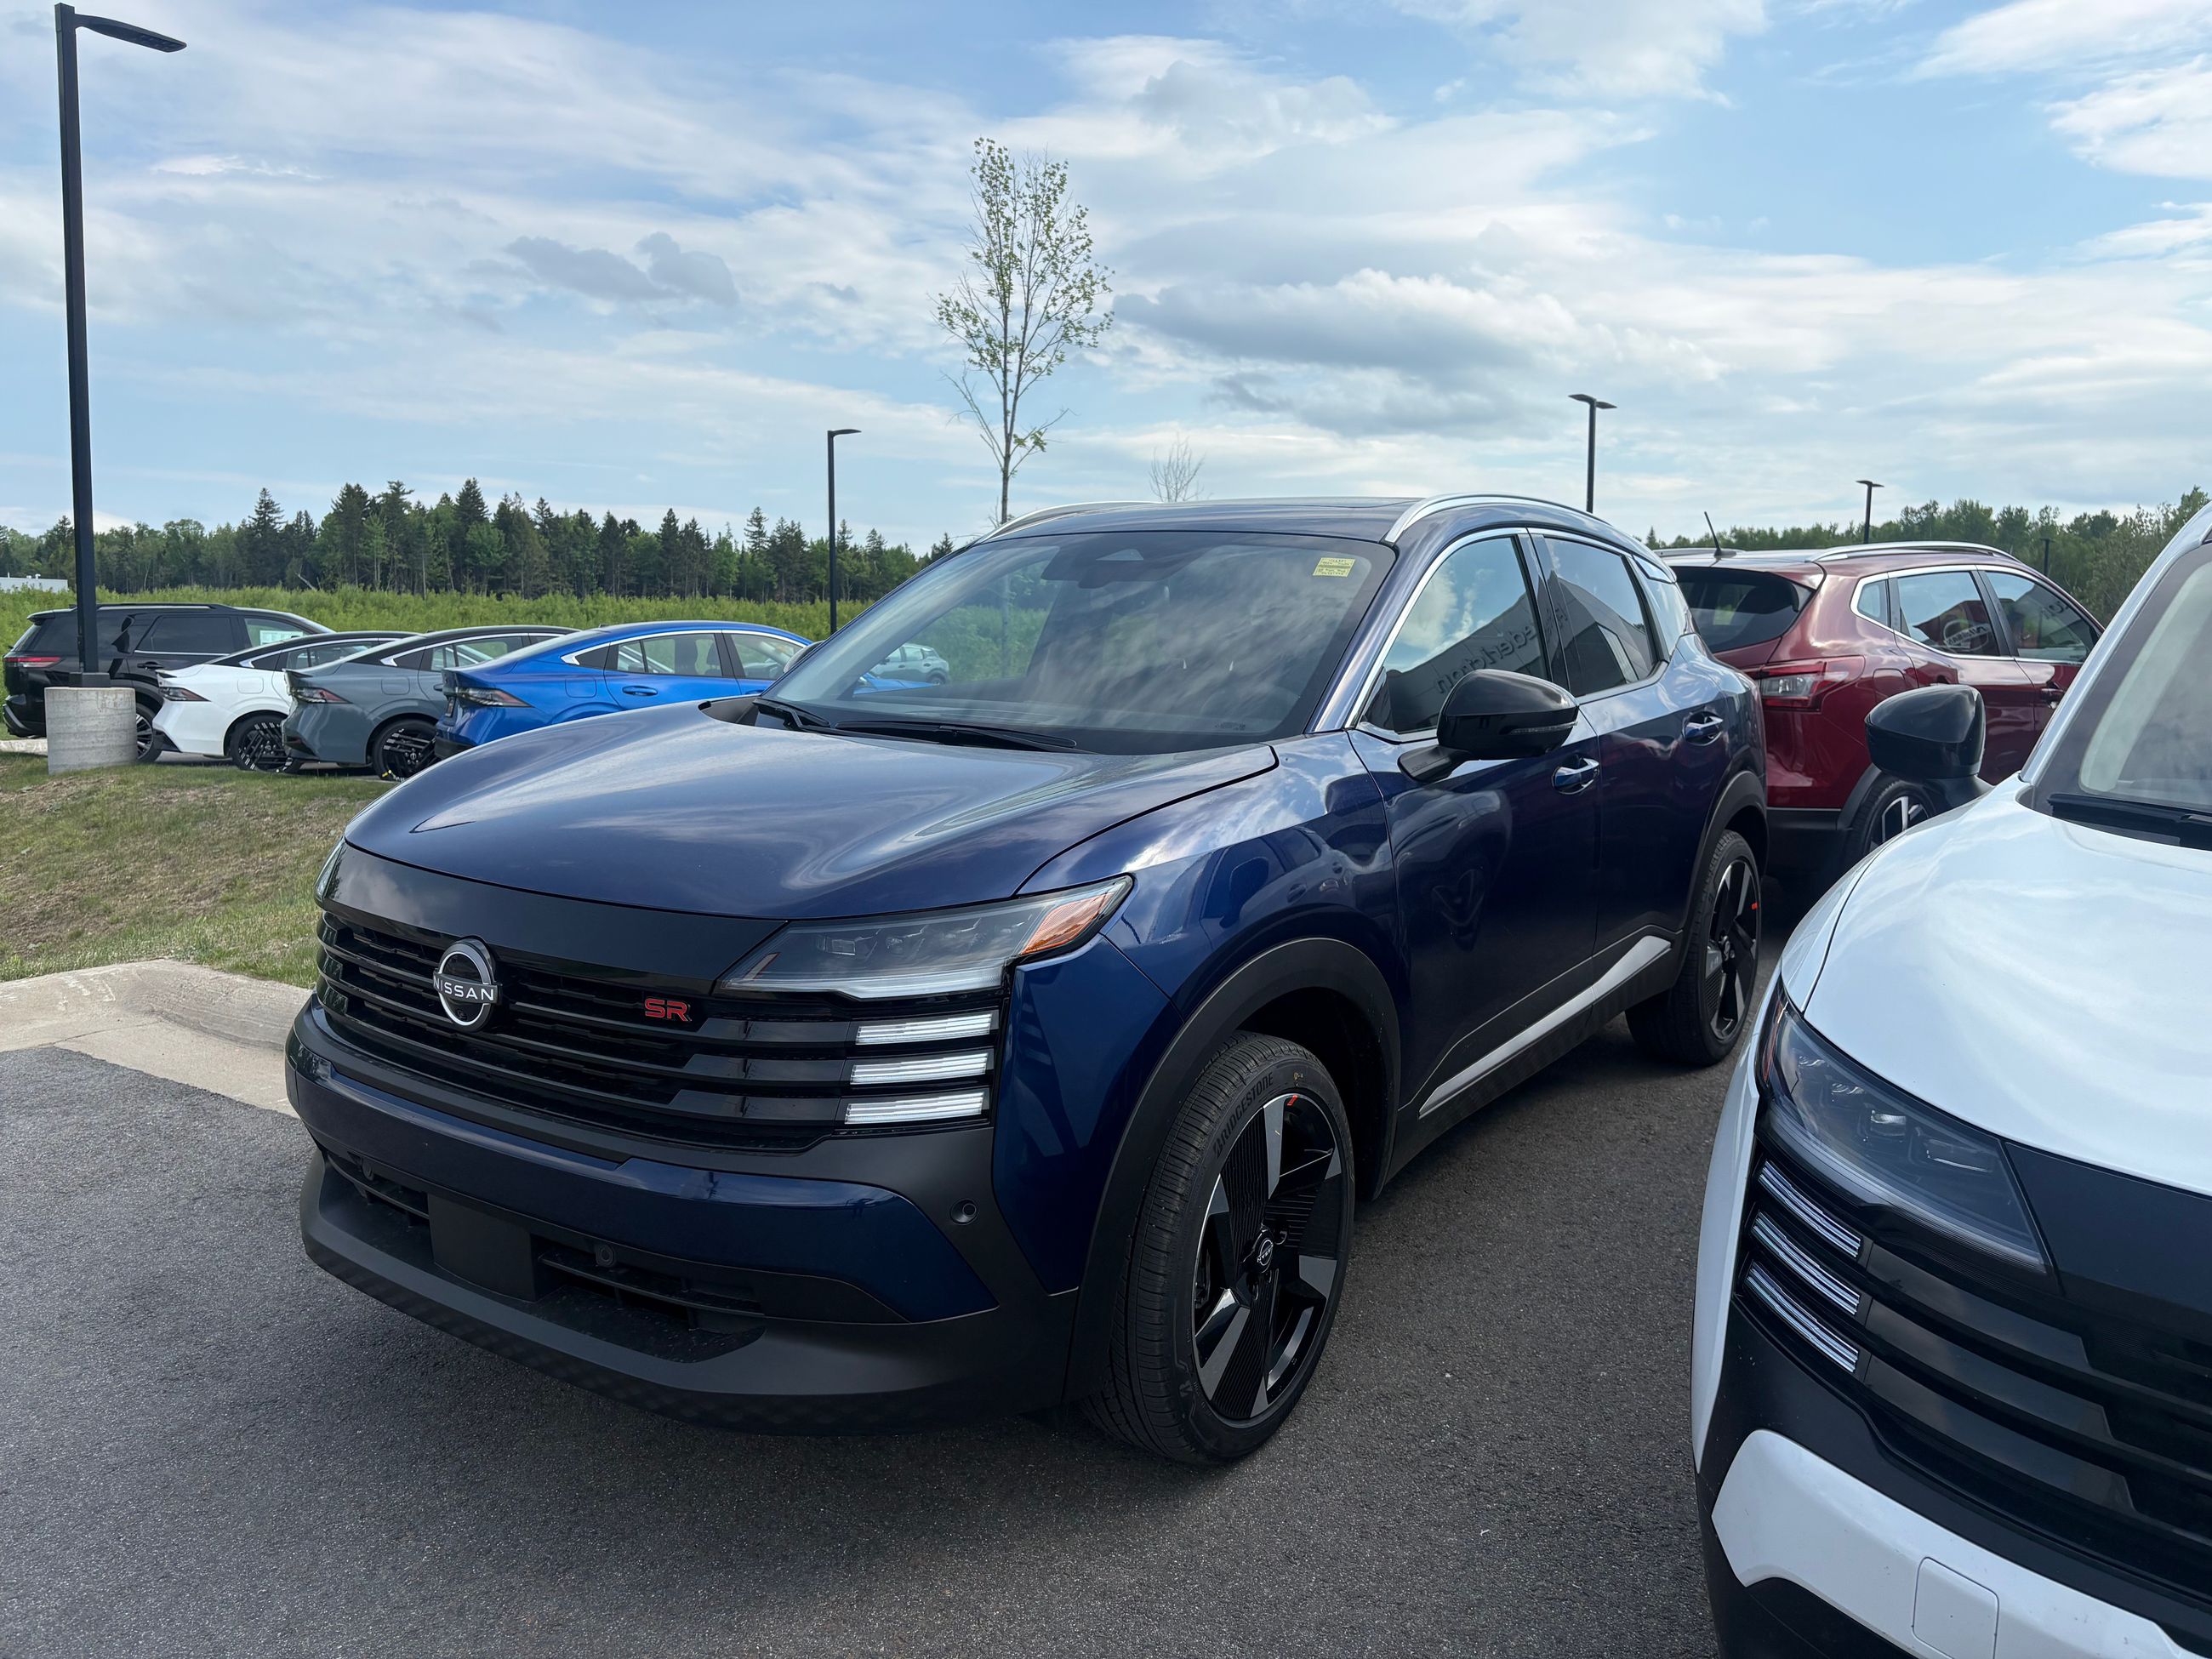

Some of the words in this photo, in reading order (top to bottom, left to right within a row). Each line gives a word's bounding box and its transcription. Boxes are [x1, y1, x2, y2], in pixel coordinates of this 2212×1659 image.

[433, 974, 494, 1001] NISSAN
[644, 997, 691, 1022] SR
[1212, 1071, 1274, 1159] BRIDGESTONE
